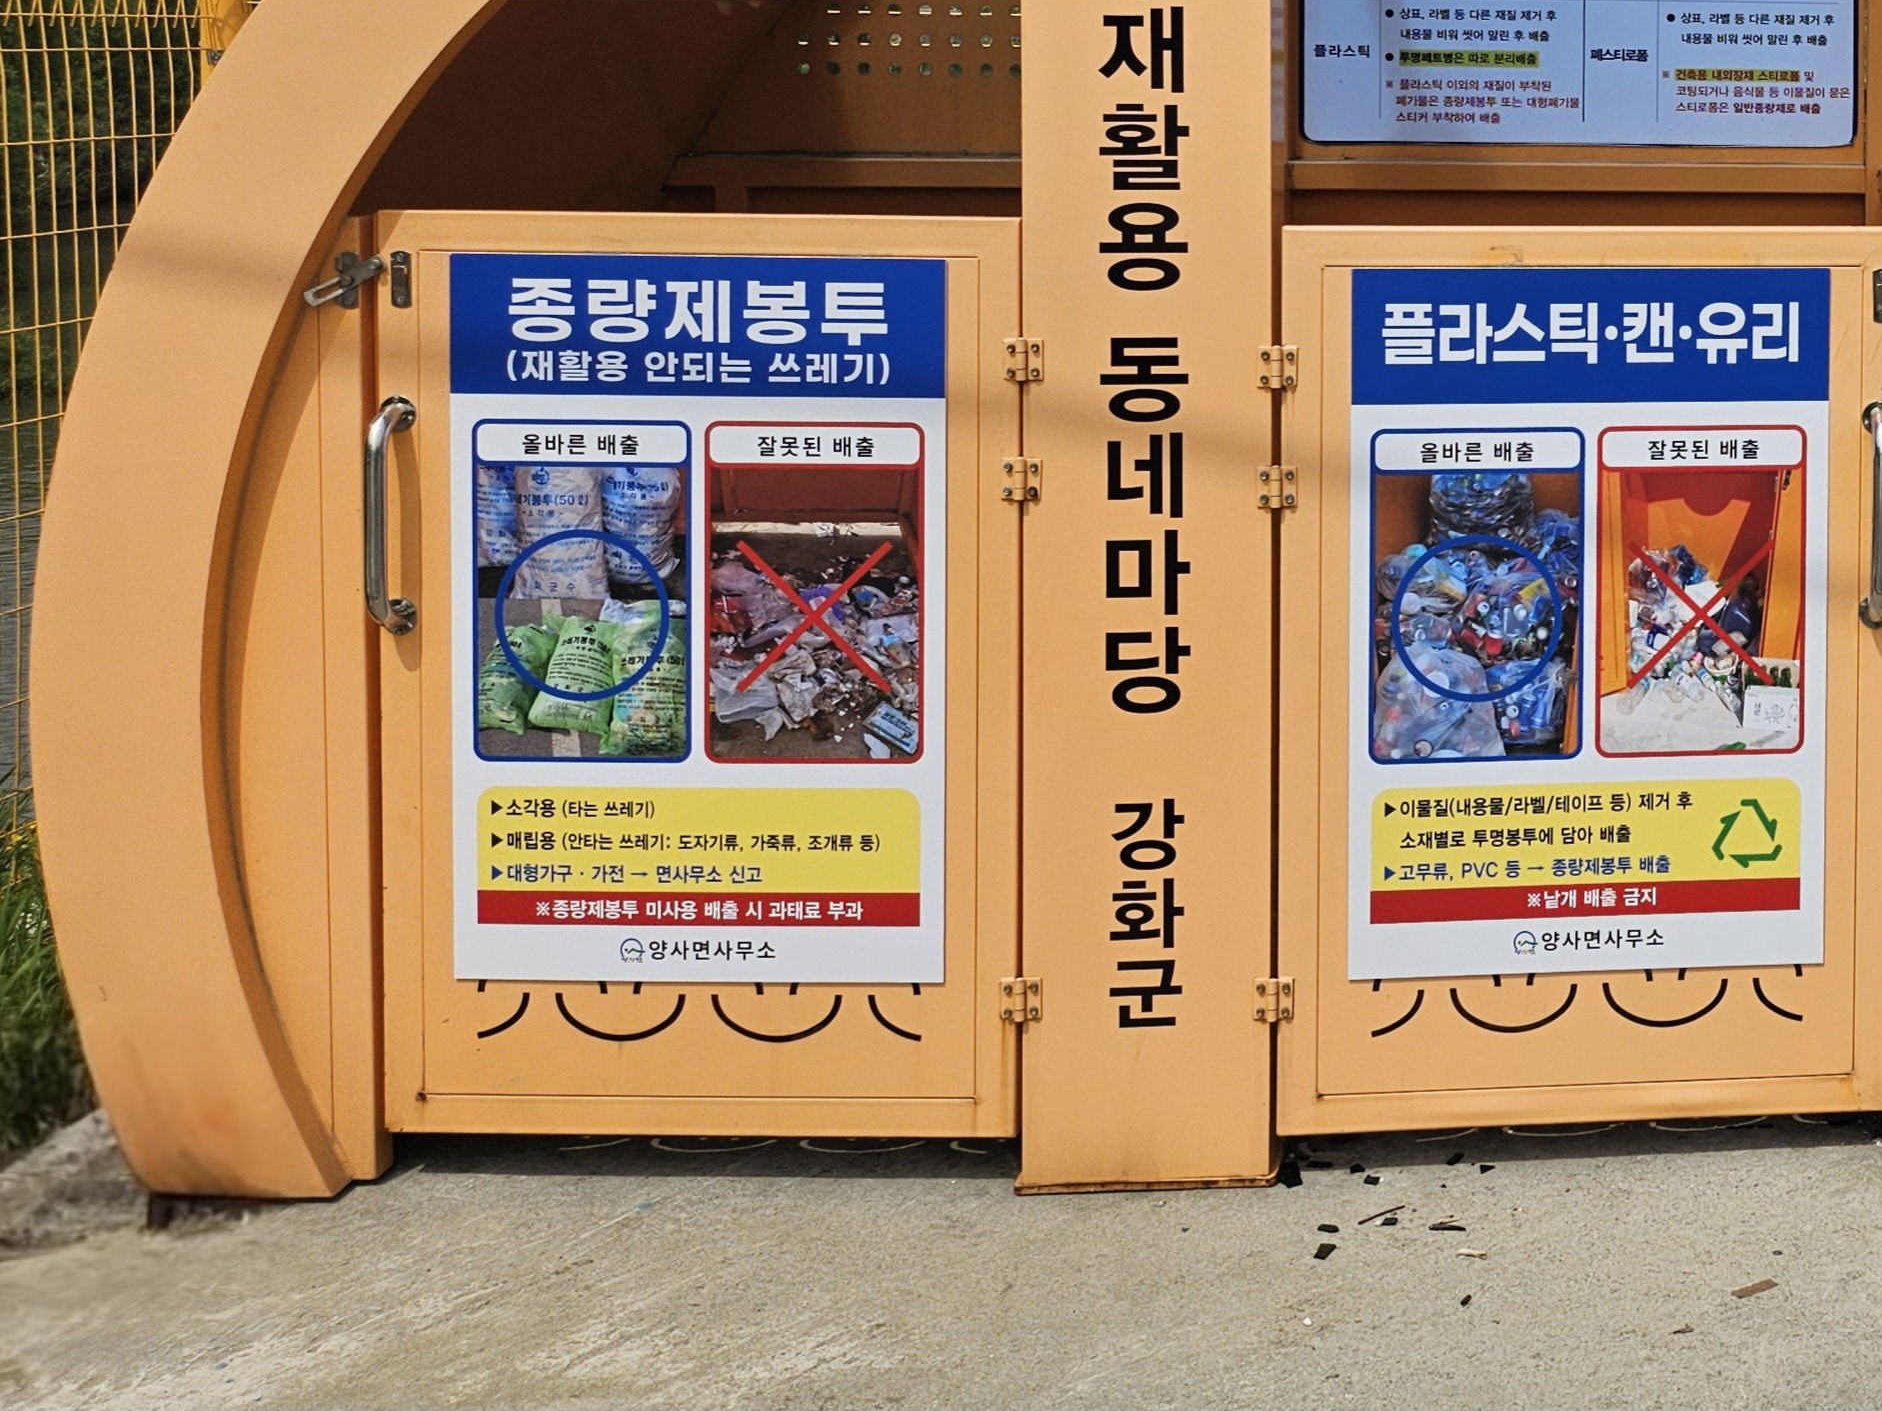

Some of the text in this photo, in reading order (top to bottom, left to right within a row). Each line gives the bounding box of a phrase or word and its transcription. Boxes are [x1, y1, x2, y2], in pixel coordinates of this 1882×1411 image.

[1429, 9, 1450, 20] 라벨
[1454, 9, 1465, 20] 등
[1469, 9, 1491, 20] 다른
[1495, 10, 1516, 20] 재질
[1520, 10, 1541, 21] 제거
[1546, 11, 1556, 21] 후
[1710, 13, 1730, 24] 라벨
[1735, 14, 1745, 25] 등
[1749, 14, 1770, 25] 다른
[1774, 15, 1795, 25] 재질
[1799, 15, 1819, 25] 제거
[1824, 15, 1834, 25] 후
[1400, 29, 1432, 40] 내용물
[1437, 29, 1458, 40] 비워
[1488, 30, 1509, 41] 말린
[1514, 30, 1524, 41] 후
[1529, 31, 1549, 41] 배출
[1682, 33, 1712, 44] 내용물
[1717, 34, 1738, 44] 비워
[1767, 35, 1788, 45] 말린
[1792, 35, 1803, 45] 후
[1807, 35, 1827, 46] 배출
[1314, 44, 1369, 58] 플라스틱
[1400, 52, 1536, 64] 투명페트병은 따로 분리배출
[1676, 70, 1813, 82] 건축용 내외장재 스티로폼 및
[509, 278, 888, 346] 종량제봉투
[507, 350, 889, 385] (재활용 안되는 쓰레기)
[522, 434, 638, 455] 올바른 배출
[758, 436, 874, 457] 잘못된 배출
[1420, 442, 1533, 463] 올바른 배출
[1649, 440, 1759, 460] 잘못된 배출
[1098, 7, 1191, 1028] 재활용 동네마당 강화군
[506, 799, 655, 818] 소각용 (타는 쓰레기)
[1610, 793, 1631, 812] 등)
[1639, 793, 1669, 810] 제거
[1677, 792, 1692, 810] 후
[507, 832, 556, 850] 매립용
[562, 833, 613, 850] (안타는
[808, 835, 853, 851] 조개류
[860, 835, 880, 852] 등)
[1400, 825, 1631, 849] 소재별로 투명봉투에 담아 배출
[592, 865, 623, 883] 가전
[657, 866, 722, 883] 면사무소
[730, 866, 762, 883] 신고
[1462, 862, 1498, 878] PVC
[1505, 861, 1520, 878] 등
[1552, 857, 1632, 877] 종량제봉투
[1640, 855, 1670, 873] 배출
[1584, 888, 1617, 907] 배출
[1623, 887, 1656, 906] 금지
[646, 901, 697, 920] 미사용
[704, 901, 739, 920] 배출
[746, 901, 762, 920] 시
[769, 901, 821, 920] 과태료
[828, 901, 863, 920] 부과
[649, 940, 775, 960] 양사면사무소
[1542, 929, 1664, 951] 양사면사무소
